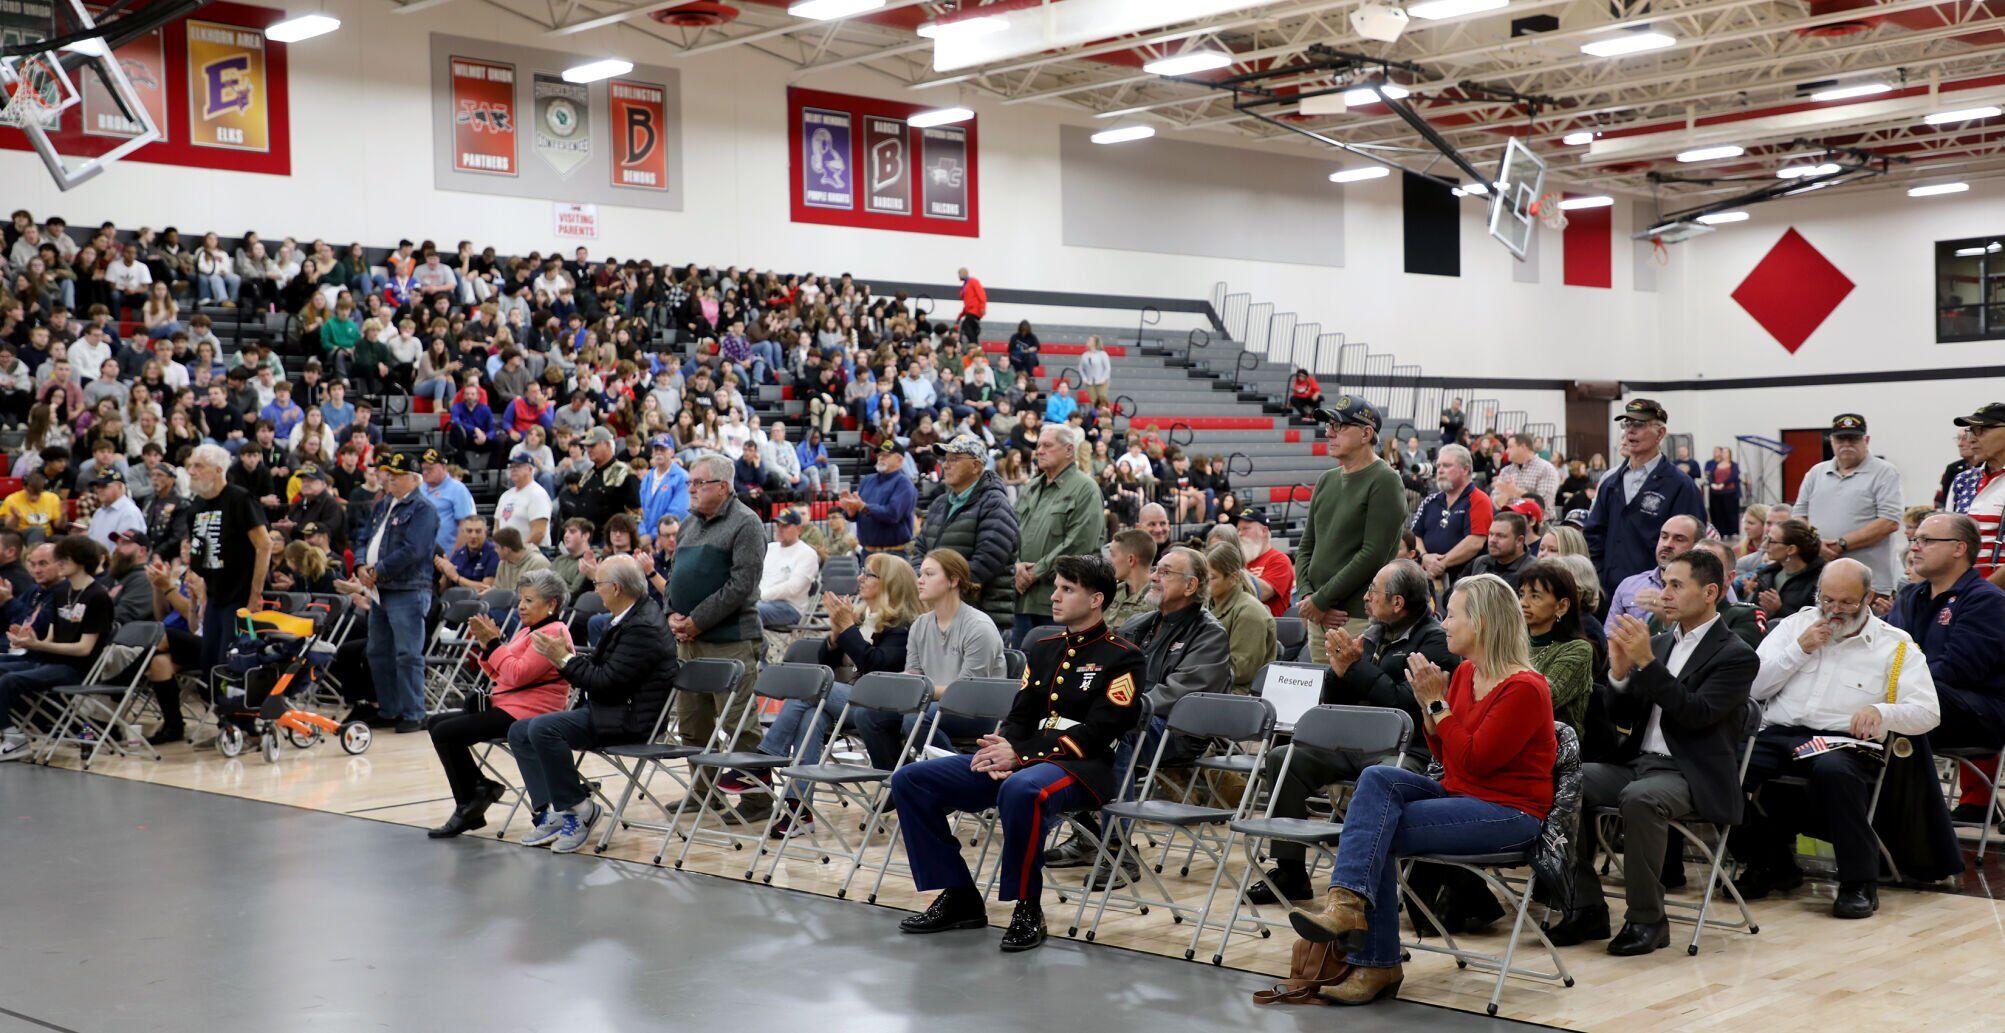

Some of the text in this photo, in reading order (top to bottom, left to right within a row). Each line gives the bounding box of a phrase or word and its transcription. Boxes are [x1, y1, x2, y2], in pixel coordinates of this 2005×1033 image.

[191, 26, 262, 48] ELKHORN AREA
[454, 63, 486, 80] WILMOT
[612, 84, 662, 103] BURLINGTON
[216, 126, 243, 144] ELKS
[463, 153, 509, 171] PANTHERS
[623, 169, 657, 185] DEMONS
[807, 190, 827, 202] PURPLE
[559, 213, 594, 225] VISITING
[558, 224, 595, 237] PARENTS
[1278, 675, 1313, 687] Reserved
